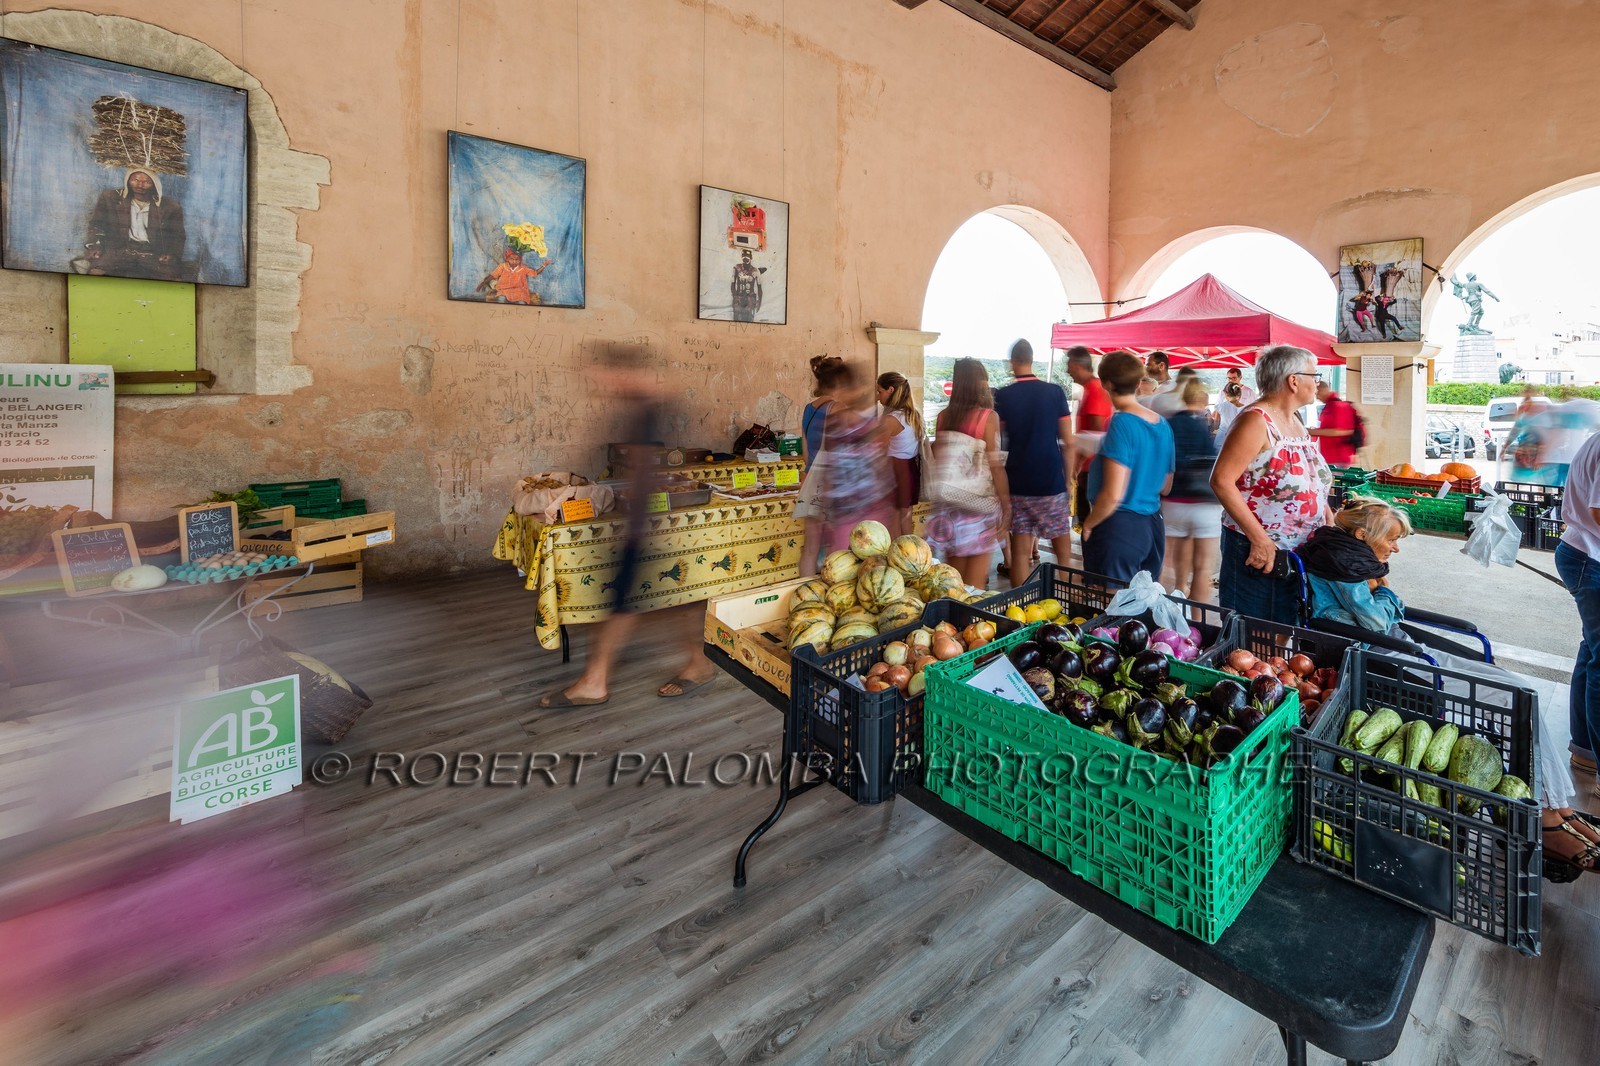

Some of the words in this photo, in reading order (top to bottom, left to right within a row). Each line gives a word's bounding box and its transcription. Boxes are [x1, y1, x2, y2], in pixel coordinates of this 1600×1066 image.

[187, 706, 279, 769] AB
[178, 745, 297, 785] AGRICULTURE
[178, 756, 297, 798] BIOLOGIQUE
[204, 779, 273, 809] CORSE
